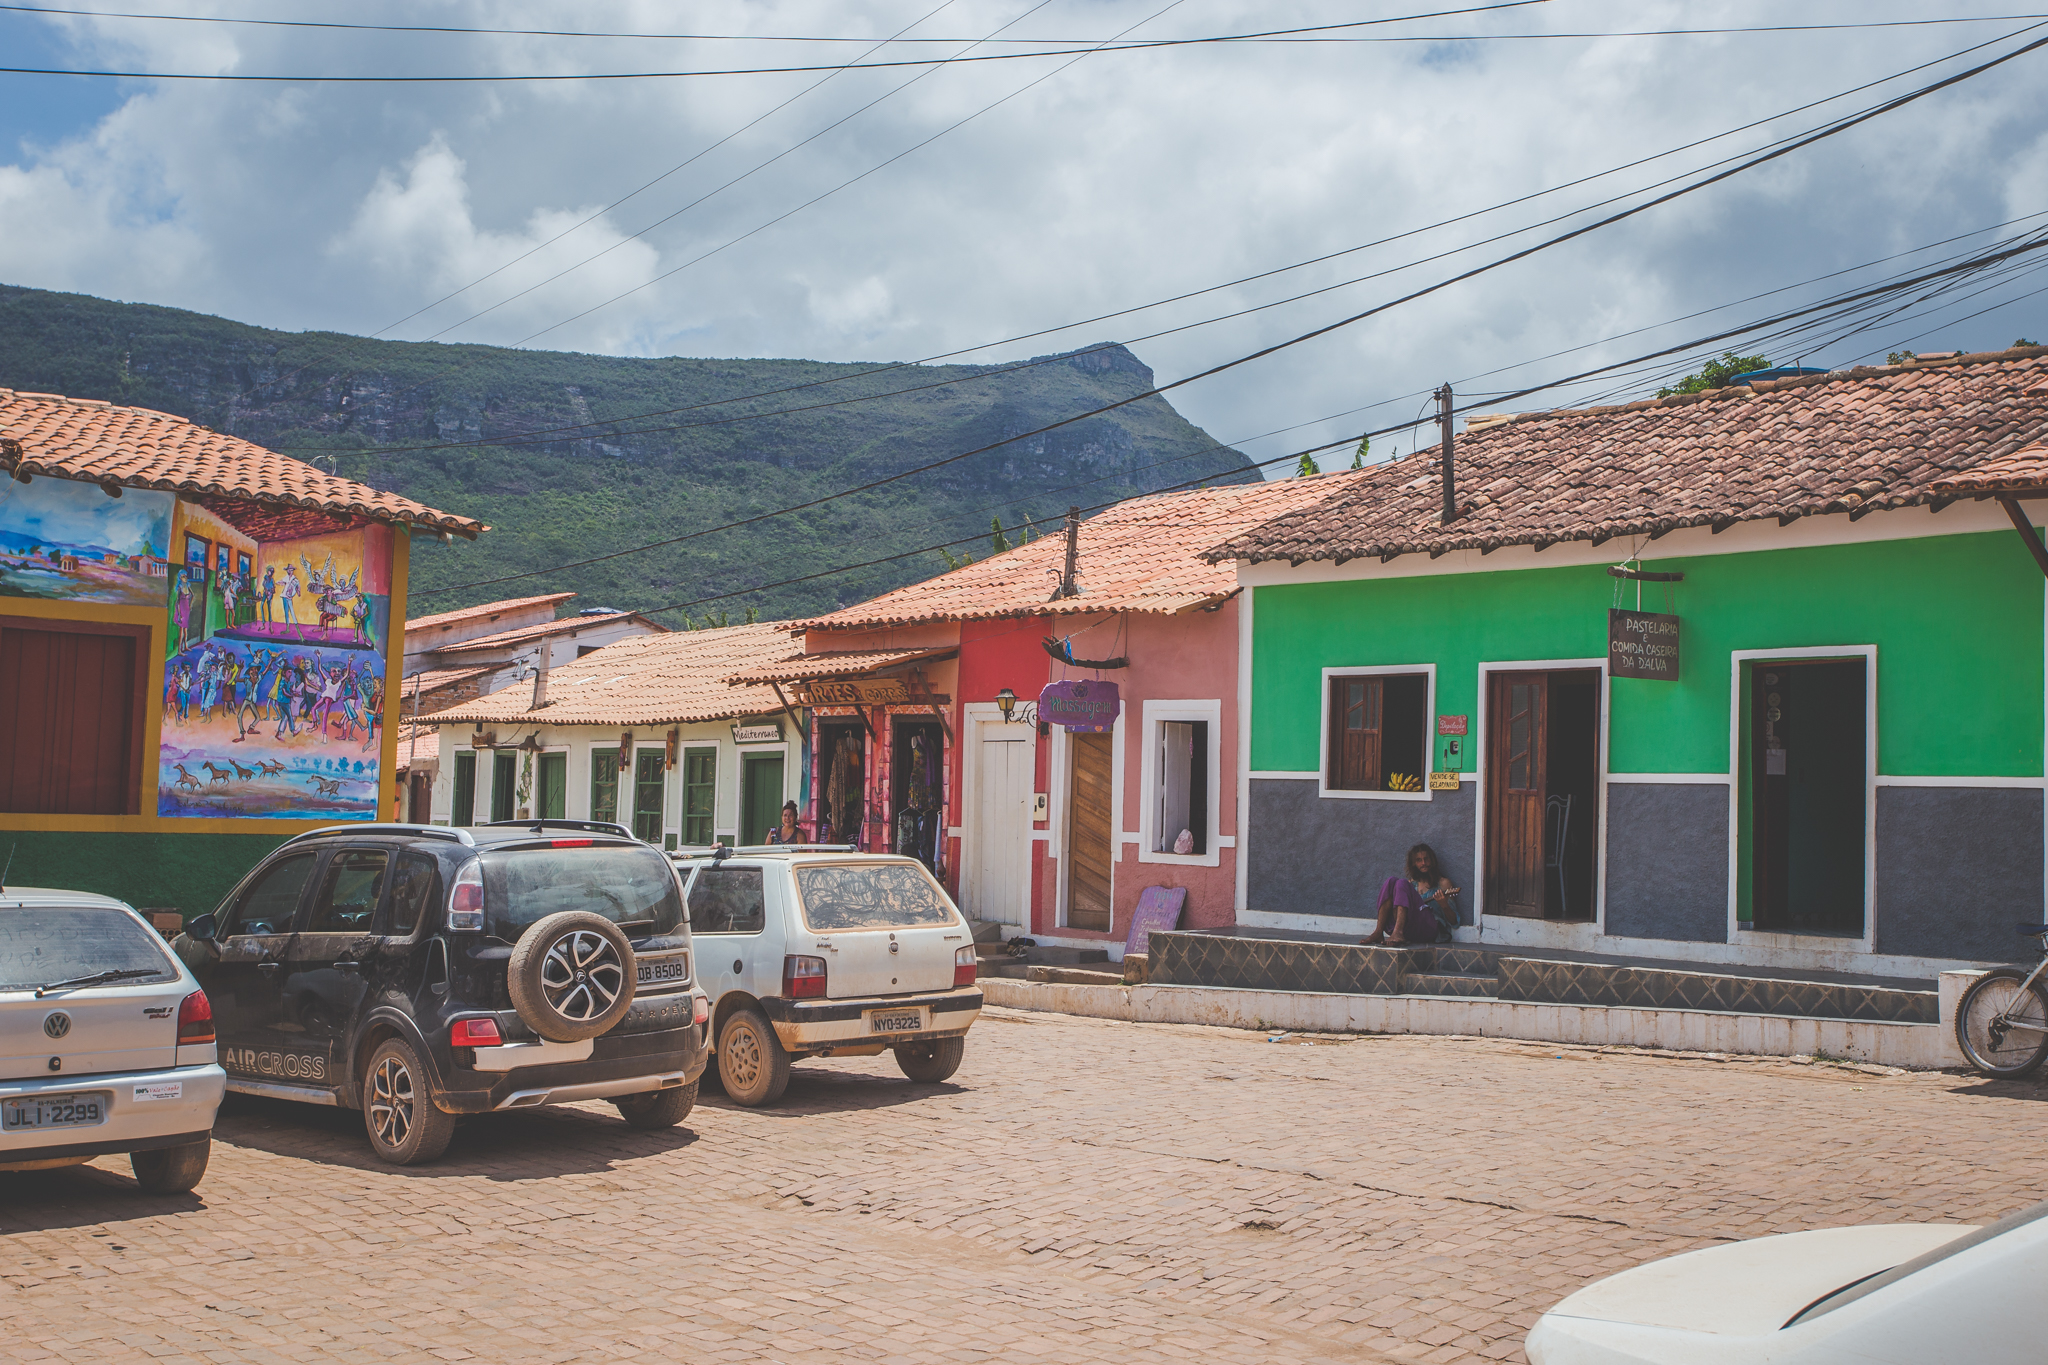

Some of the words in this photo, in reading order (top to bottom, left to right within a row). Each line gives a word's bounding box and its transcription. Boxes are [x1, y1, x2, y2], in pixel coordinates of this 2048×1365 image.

[1626, 618, 1678, 636] PASTELARIA
[1611, 640, 1644, 655] COMIDA
[1645, 643, 1678, 659] CASEIRA
[1622, 655, 1635, 668] DA
[1049, 696, 1112, 720] Massagem
[226, 1047, 325, 1079] AIRCROSS
